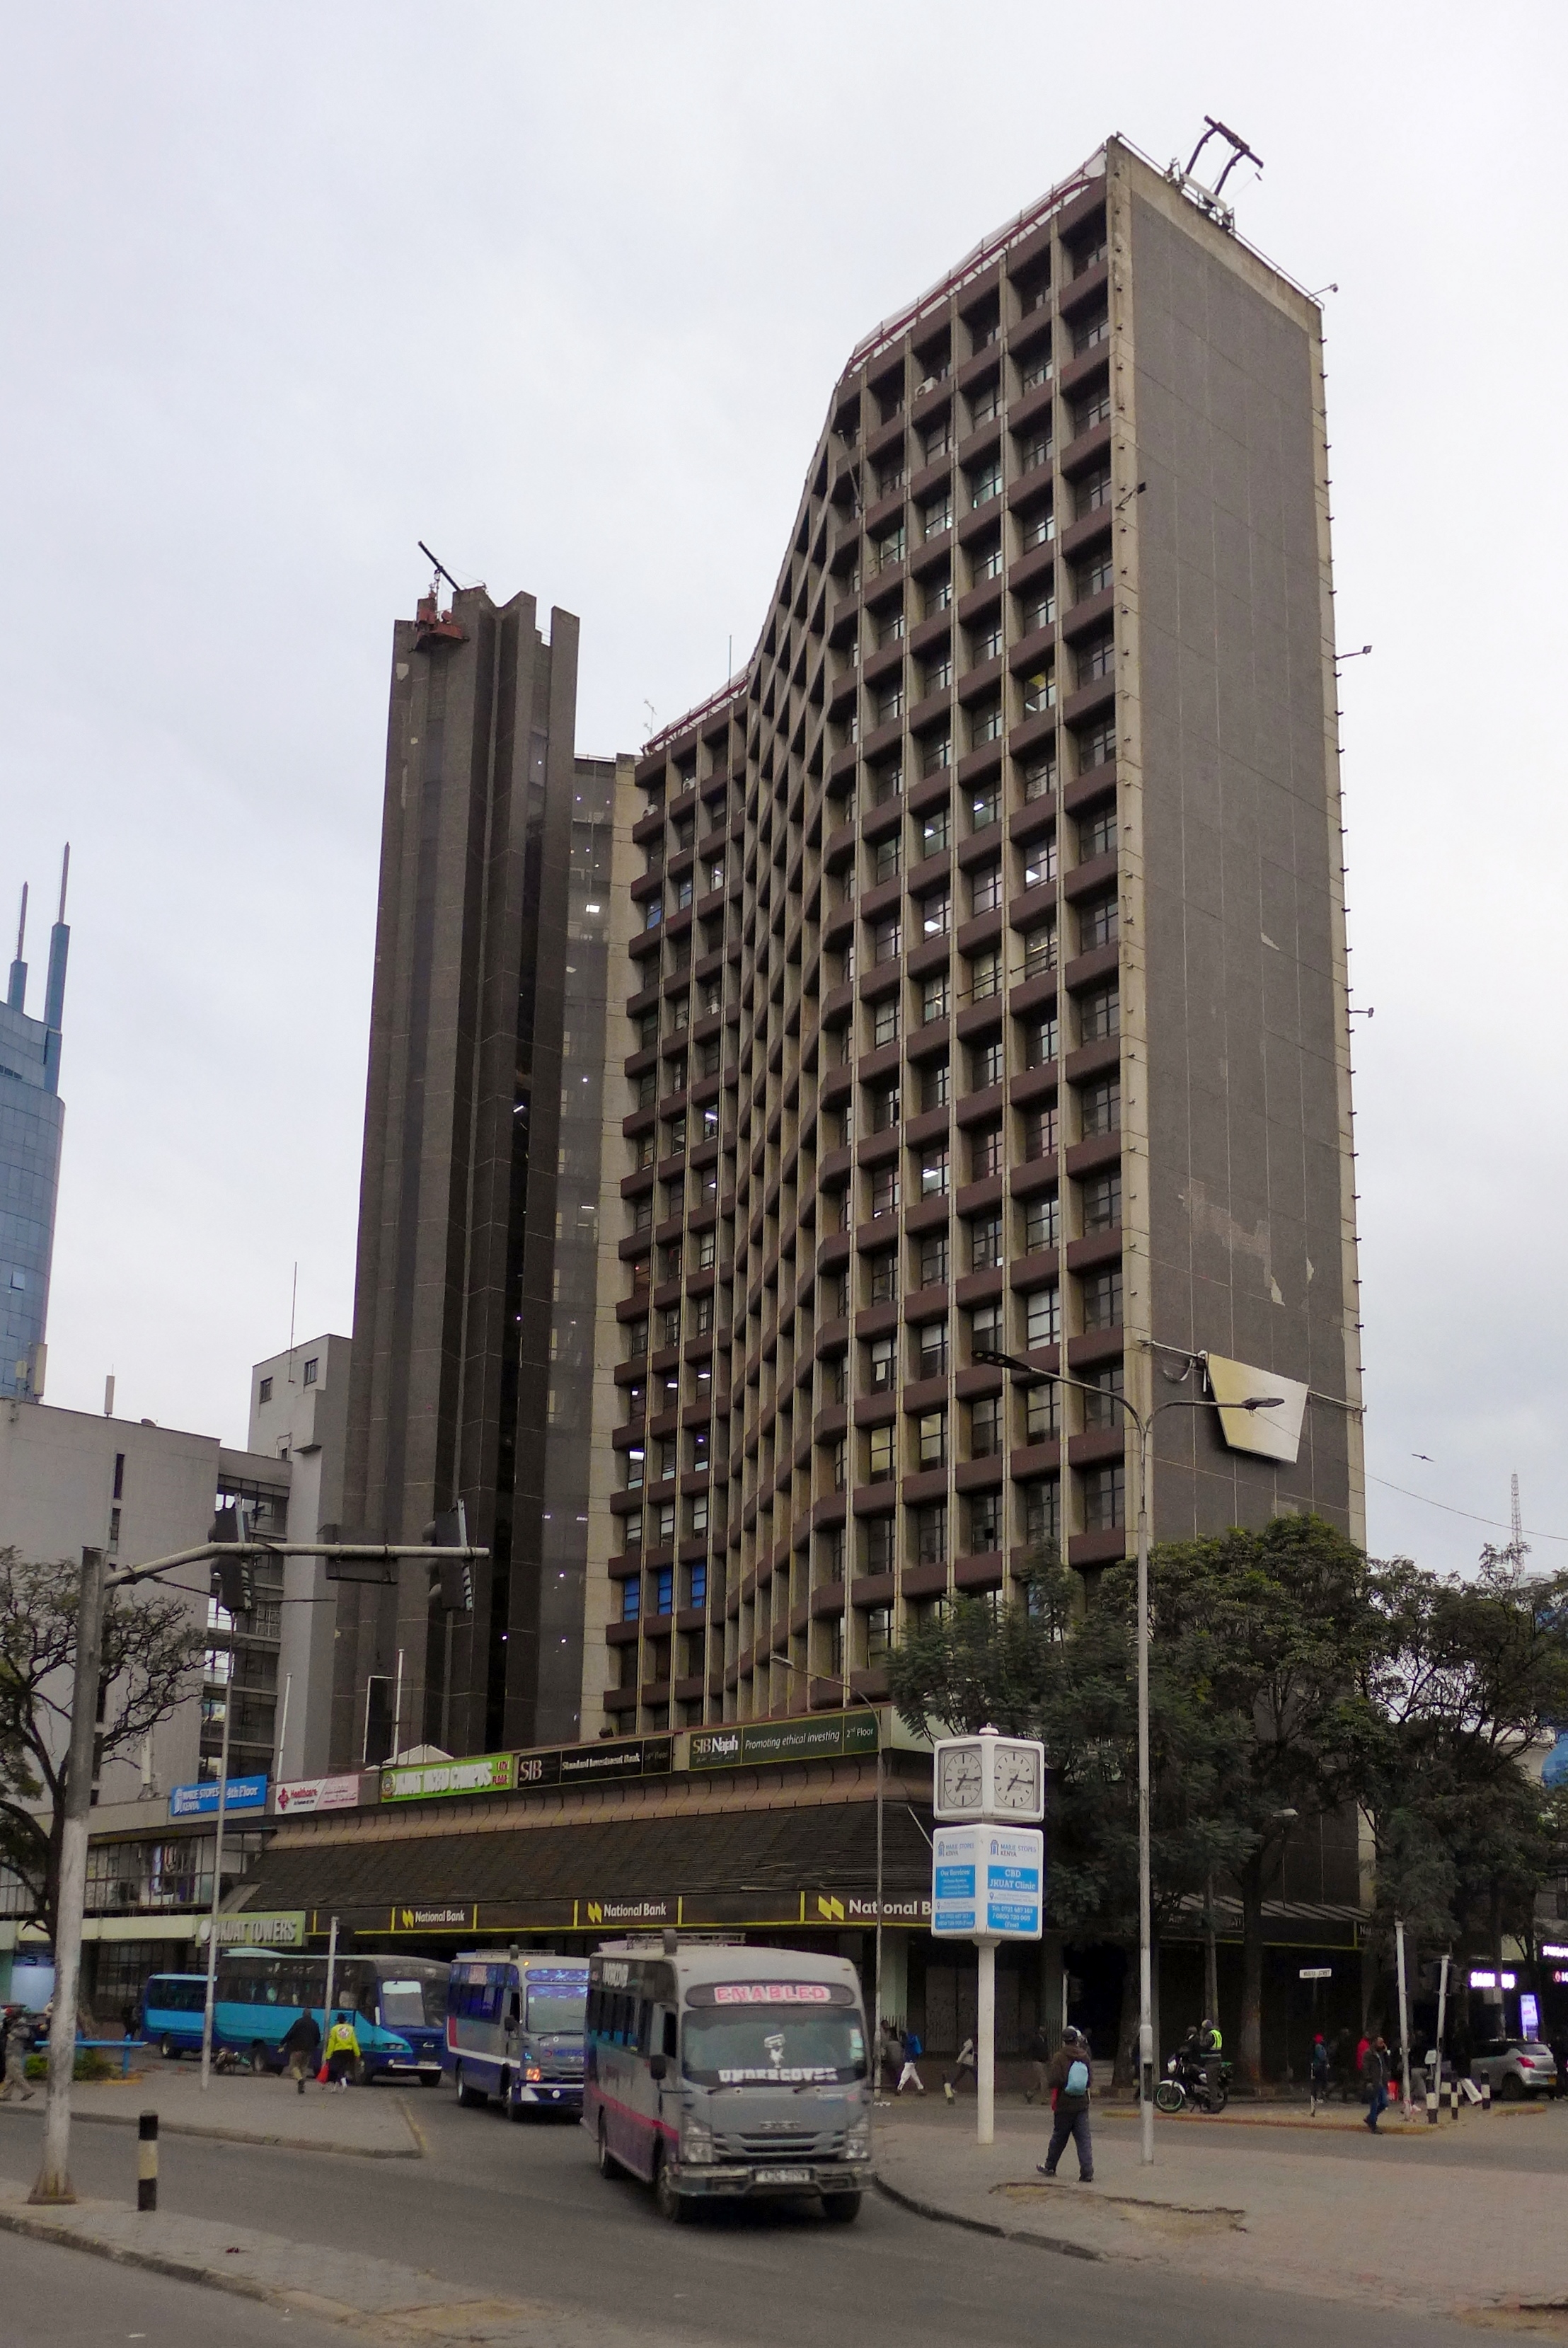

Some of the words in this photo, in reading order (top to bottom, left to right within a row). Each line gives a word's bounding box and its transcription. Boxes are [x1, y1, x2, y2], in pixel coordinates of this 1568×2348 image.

[745, 1737, 780, 1750] Promoting
[782, 1732, 805, 1746] ethical
[807, 1730, 840, 1743] investing
[857, 1727, 874, 1737] Floor
[692, 1737, 710, 1754] SIB
[712, 1734, 738, 1755] Najah
[562, 1759, 589, 1770] Standard
[589, 1755, 623, 1767] Investment
[623, 1753, 640, 1763] Bank
[450, 1761, 492, 1790] CAMPUS
[519, 1760, 542, 1781] SIB
[226, 1786, 238, 1799] 4th
[239, 1785, 258, 1797] Floor
[1005, 1869, 1021, 1878] CBD
[990, 1878, 1014, 1889] JKUAT
[1015, 1880, 1036, 1890] Clinic
[604, 1903, 641, 1917] National
[643, 1902, 667, 1916] Bank
[849, 1899, 918, 1915] Natonal
[415, 1910, 445, 1923] National
[446, 1909, 465, 1922] Bank
[251, 1918, 297, 1942] TOWERS
[714, 1986, 831, 2003] ENABLED
[717, 2068, 838, 2083] UNDERCOVER
